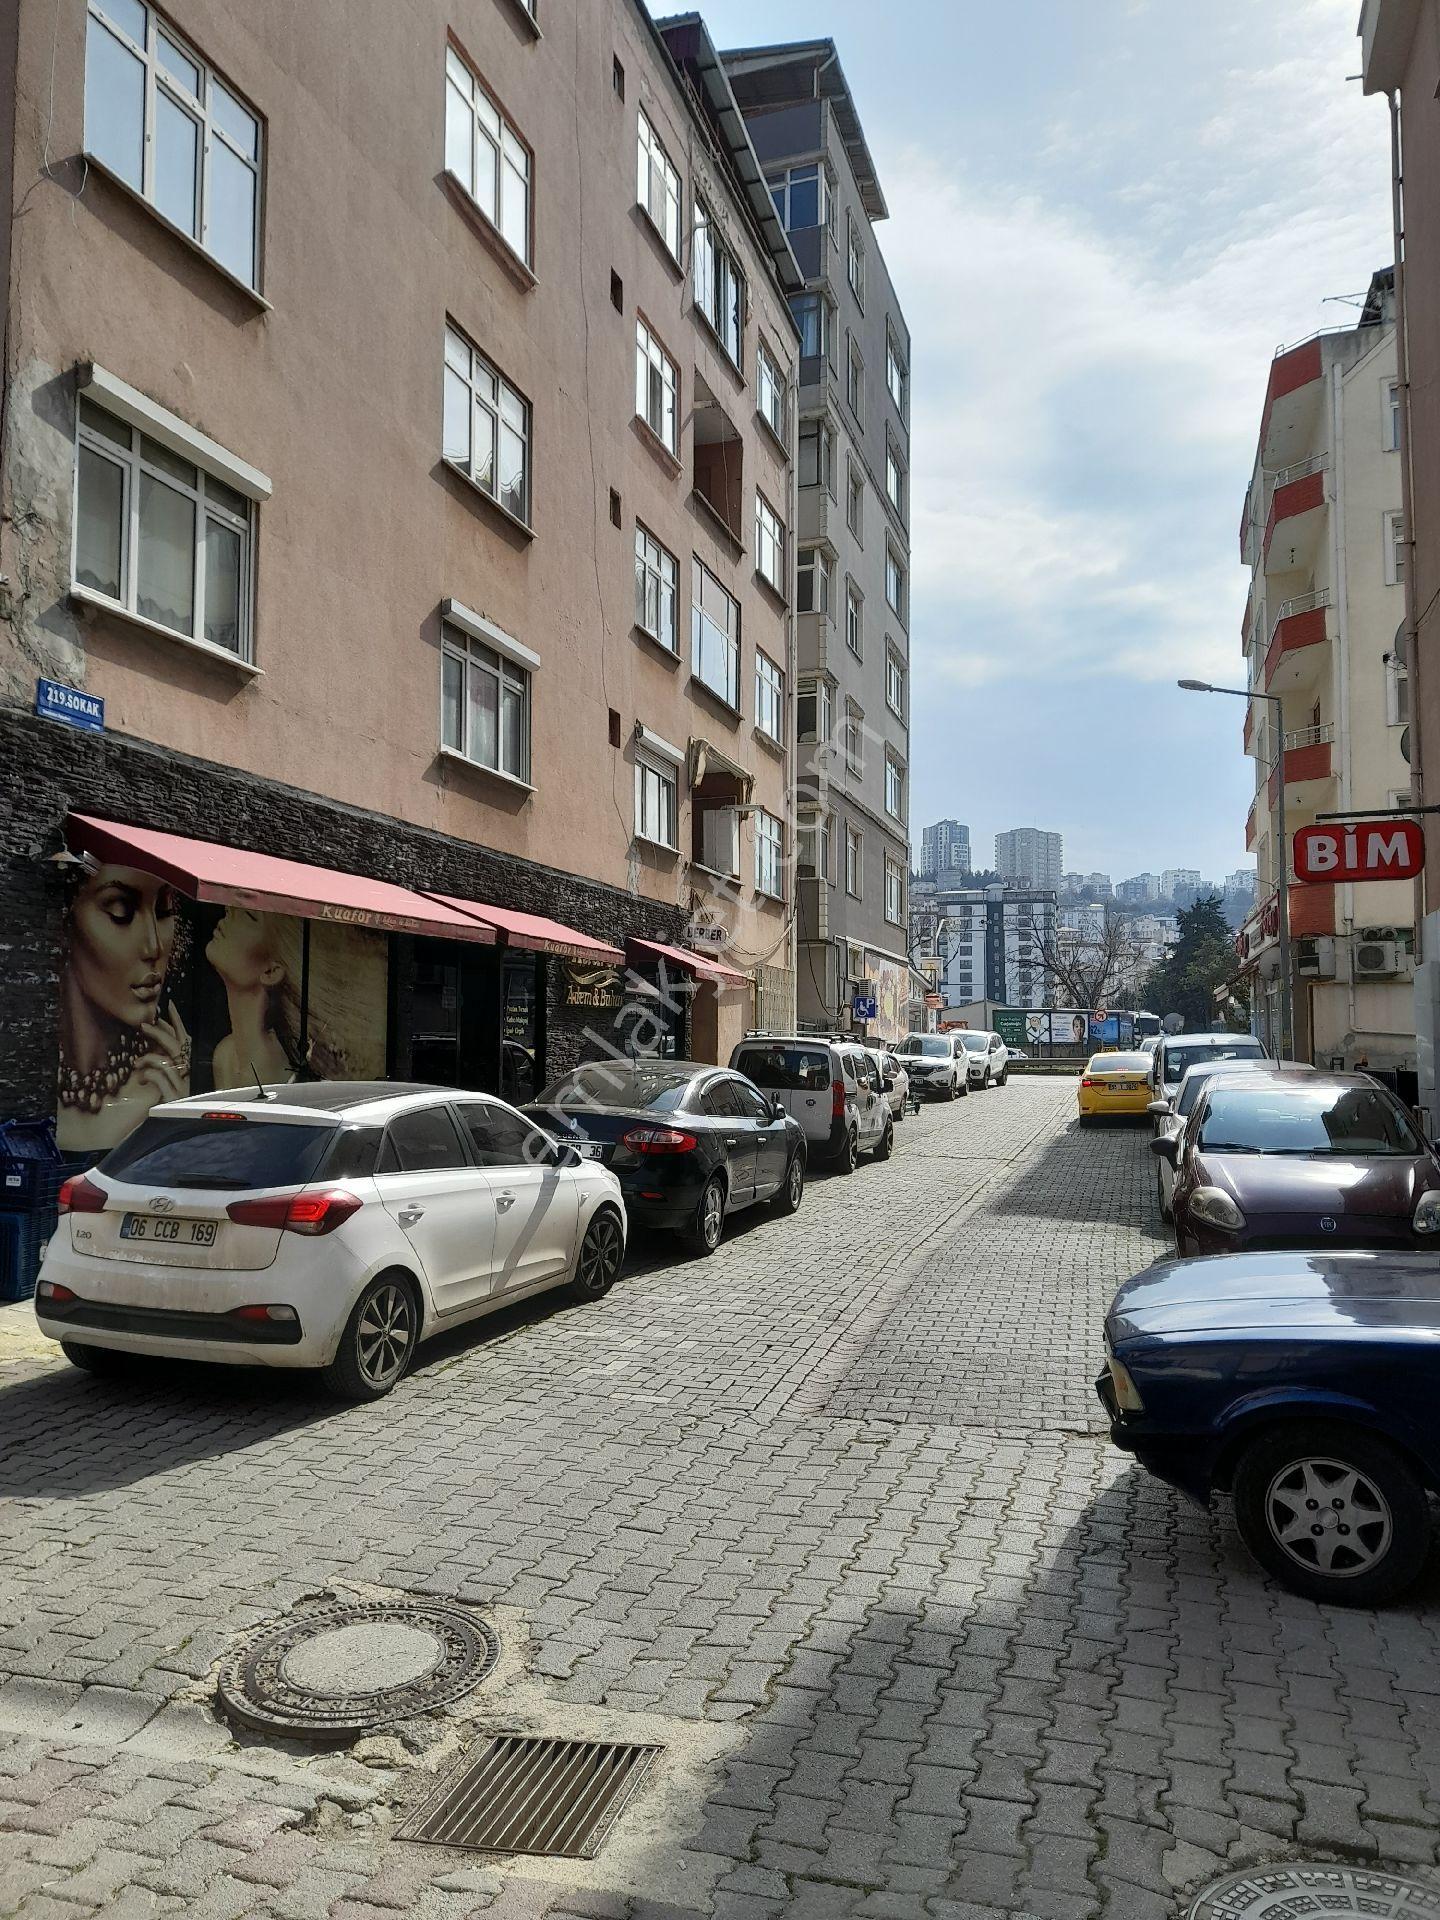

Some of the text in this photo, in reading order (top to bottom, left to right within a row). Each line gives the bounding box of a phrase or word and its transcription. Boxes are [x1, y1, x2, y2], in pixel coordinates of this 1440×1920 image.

[46, 686, 101, 718] 219.SOKAK
[1306, 824, 1411, 872] BİM
[322, 904, 372, 924] Kuaför
[686, 926, 722, 941] BERBER
[592, 987, 601, 1007] &
[866, 998, 875, 1009] P
[129, 1218, 214, 1242] 06 CCB 169
